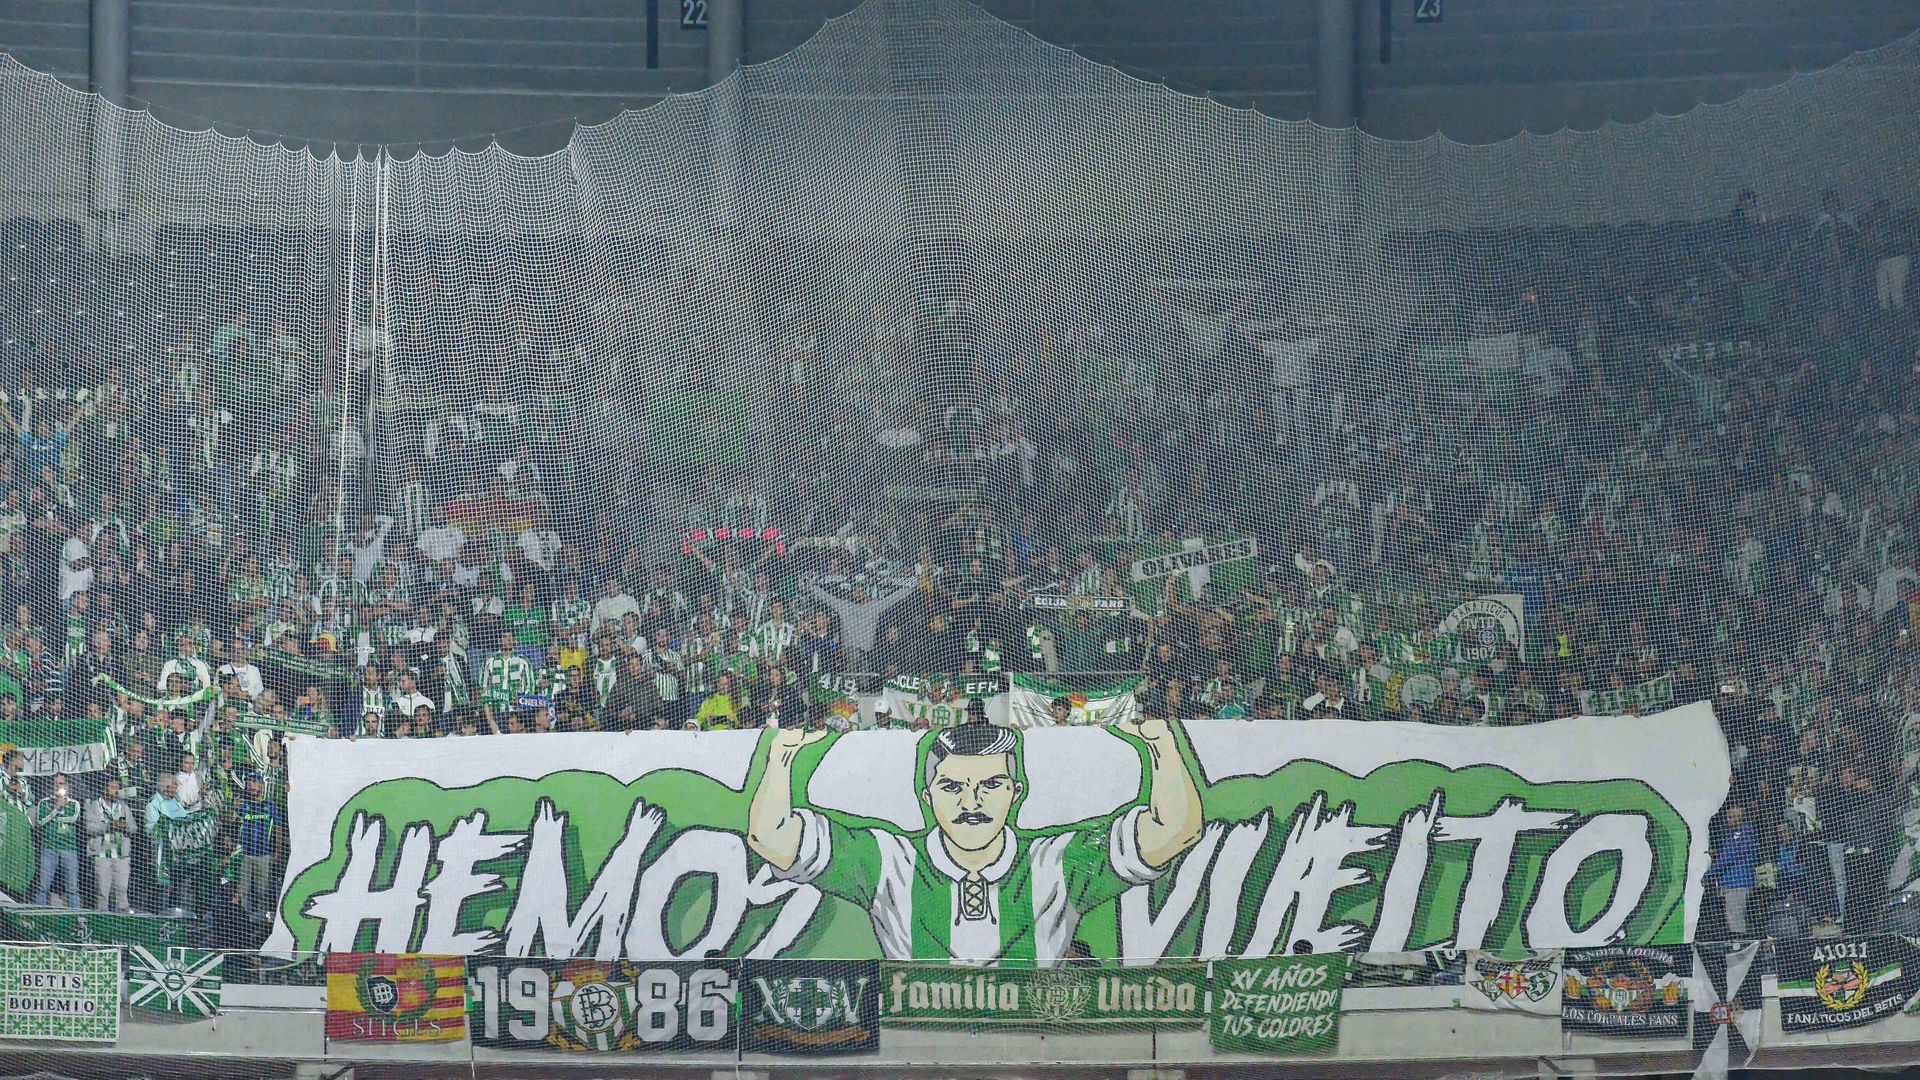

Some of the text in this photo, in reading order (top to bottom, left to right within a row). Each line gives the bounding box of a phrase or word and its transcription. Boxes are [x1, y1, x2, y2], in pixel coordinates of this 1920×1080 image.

[682, 0, 707, 25] 22
[1142, 541, 1251, 576] OLIVARES
[22, 746, 94, 774] MERIDA
[302, 798, 822, 960] HEMOS
[1813, 942, 1868, 962] 41011
[23, 974, 83, 989] BETIS
[1231, 963, 1328, 991] XV AÑOS
[9, 997, 95, 1013] BOHEMIO
[1220, 988, 1338, 1015] DEFENDIENDO
[1853, 1006, 1874, 1020] DEL
[1874, 994, 1903, 1013] BETIS
[352, 1017, 442, 1037] SITGES
[1223, 1012, 1334, 1039] TUS COLORES
[1562, 1006, 1584, 1021] LOS
[1649, 1014, 1678, 1026] FANS
